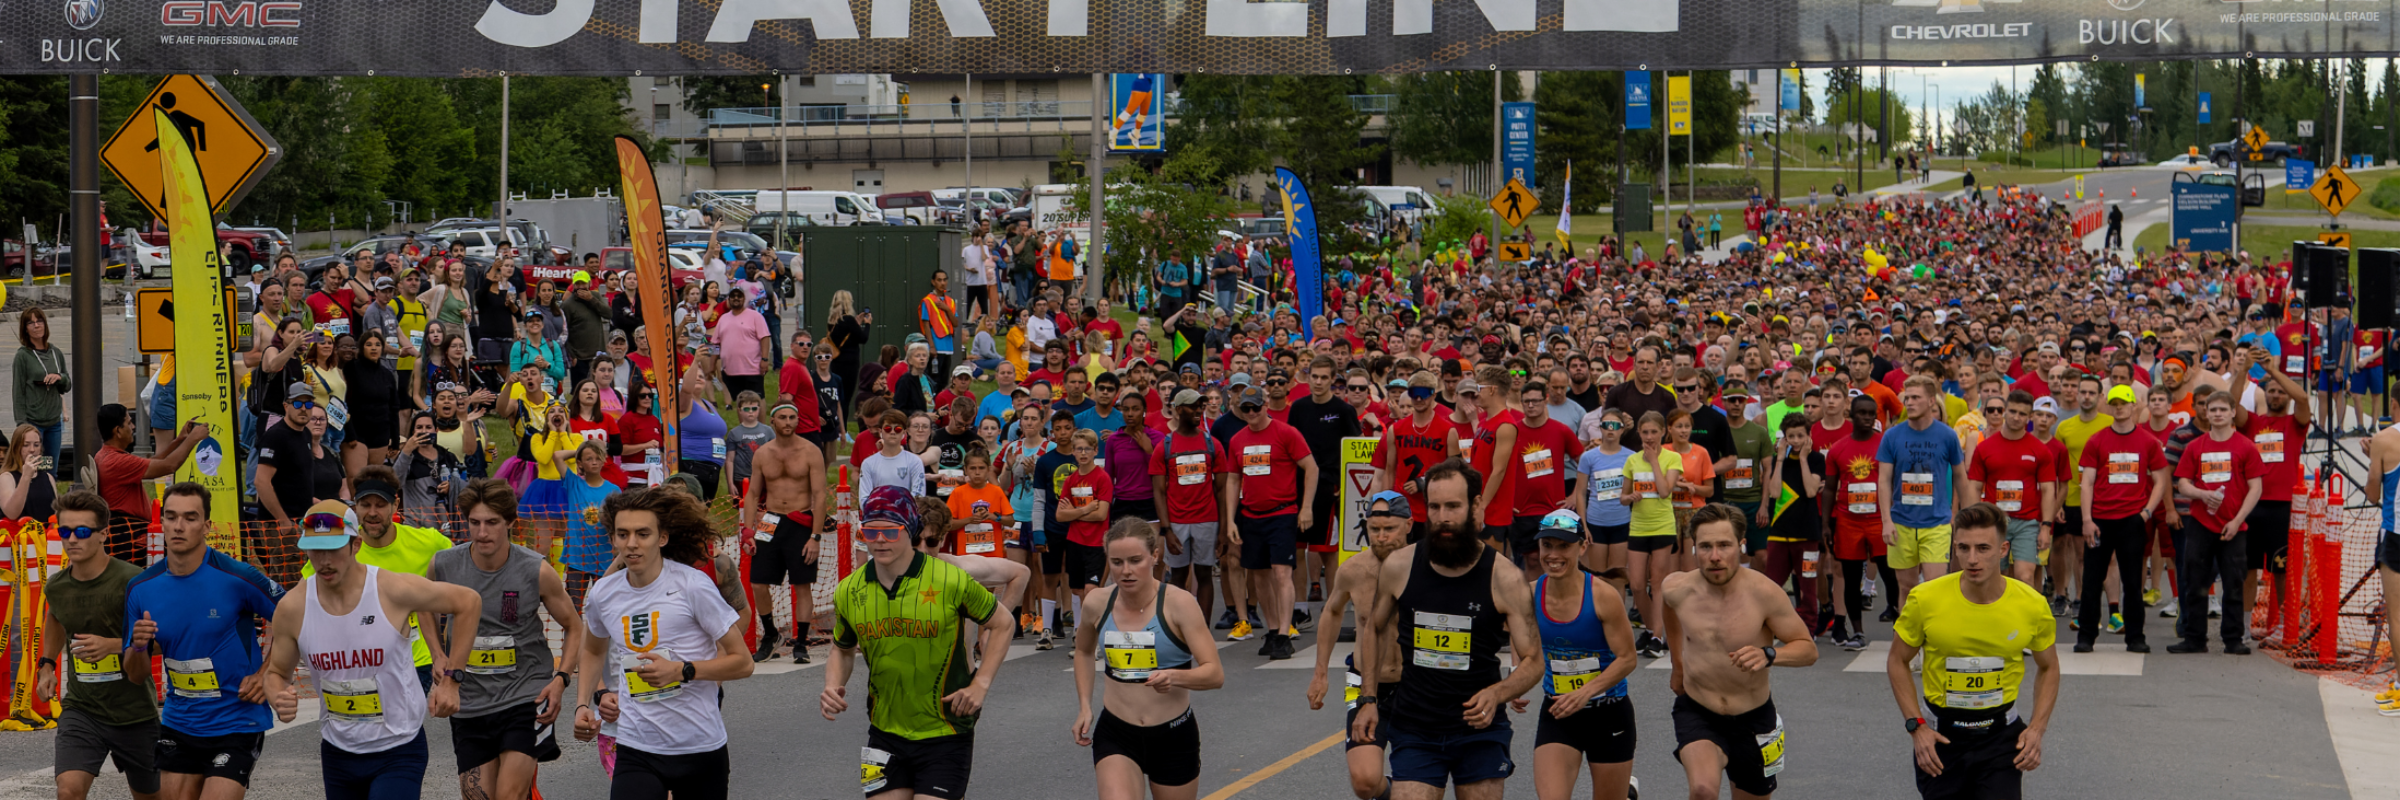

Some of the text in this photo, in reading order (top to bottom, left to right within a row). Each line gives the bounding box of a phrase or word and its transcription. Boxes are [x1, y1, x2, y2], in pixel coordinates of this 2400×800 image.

[162, 1, 300, 27] GMC
[2220, 11, 2380, 24] WE ARE PROFESSIONAL GRADE
[1891, 22, 2033, 40] CHEVROLET
[2079, 18, 2174, 45] BUICK
[160, 35, 299, 46] WE ARE PROFESSIONAL GRADE
[41, 38, 122, 62] BUICK
[1308, 227, 1318, 257] BLUE
[655, 231, 671, 318] ORANGE
[1312, 260, 1320, 309] CORRAL
[820, 386, 839, 401] SA
[1350, 441, 1378, 451] STATE
[1396, 435, 1445, 452] THING
[1249, 455, 1262, 464] 424
[1354, 450, 1375, 459] LAW
[1533, 462, 1546, 470] 315
[1601, 479, 1620, 489] 2326
[1639, 482, 1653, 491] 293
[1909, 485, 1924, 493] 403
[1855, 494, 1868, 502] 327
[973, 533, 986, 541] 172
[855, 616, 939, 642] PAKISTAN
[1434, 634, 1450, 648] 12
[308, 648, 384, 671] HIGHLAND
[481, 652, 496, 664] 21
[1124, 652, 1133, 665] 7
[187, 676, 196, 688] 4
[1569, 678, 1584, 690] 19
[1966, 676, 1984, 688] 20
[346, 699, 356, 711] 2
[1170, 715, 1187, 729] NIKE
[1954, 718, 1995, 728] SALOMON
